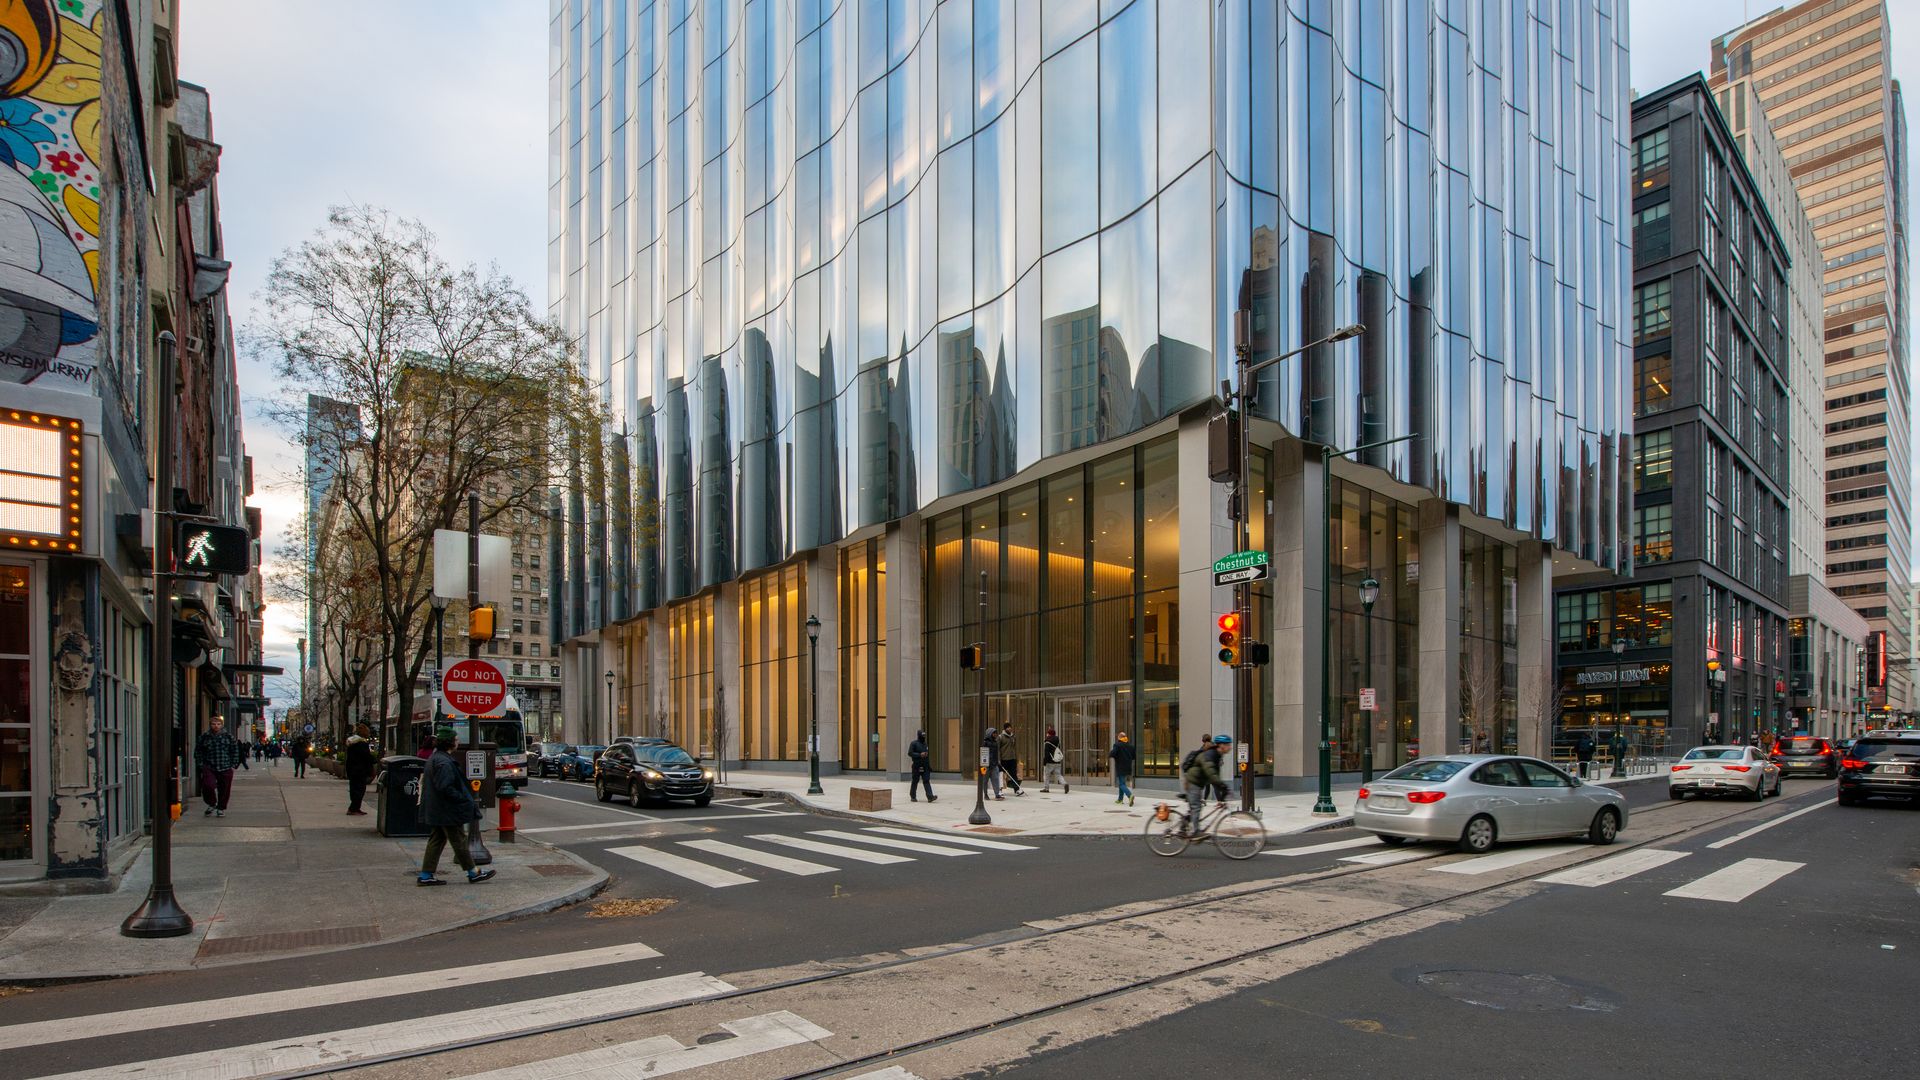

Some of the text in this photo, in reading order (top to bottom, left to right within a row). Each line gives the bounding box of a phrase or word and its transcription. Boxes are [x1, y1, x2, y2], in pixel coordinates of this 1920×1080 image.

[1215, 556, 1254, 572] Chestnut
[1257, 553, 1266, 564] St
[1221, 571, 1249, 582] ONE WAY
[453, 669, 497, 681] DO NOT
[456, 694, 492, 705] ENTER
